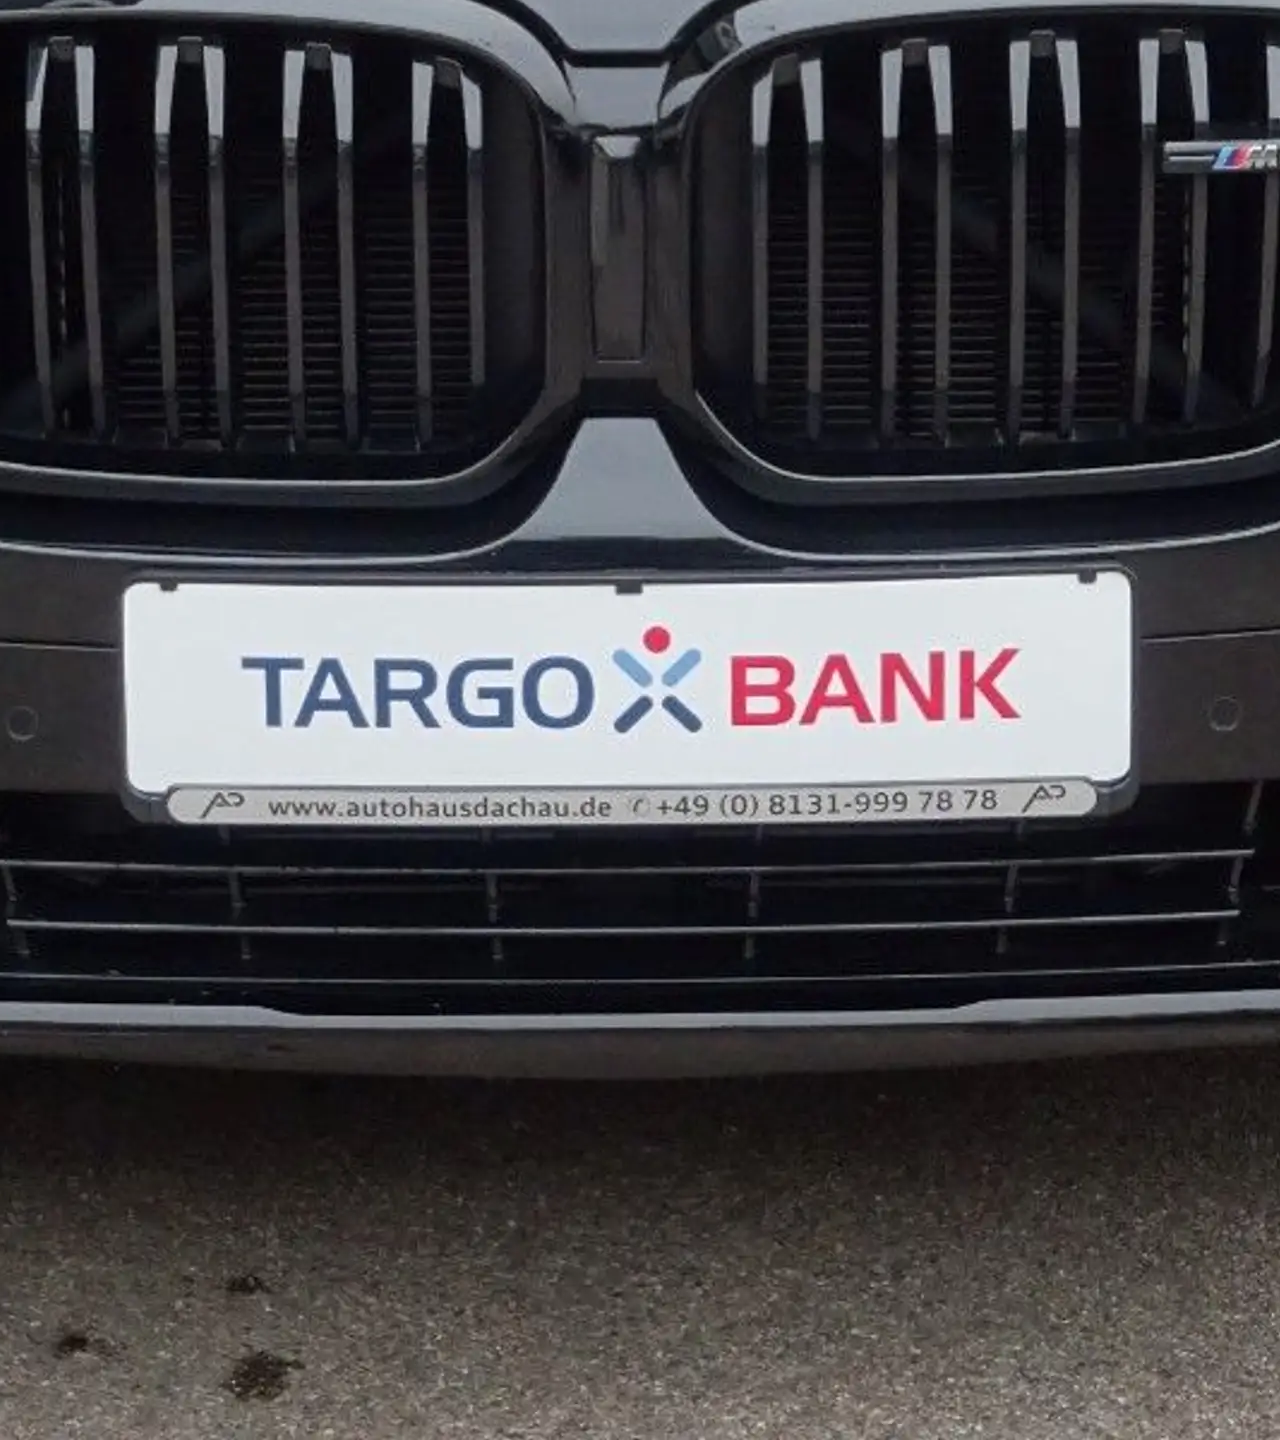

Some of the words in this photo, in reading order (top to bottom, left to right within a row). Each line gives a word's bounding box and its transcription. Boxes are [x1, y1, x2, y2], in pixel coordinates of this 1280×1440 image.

[240, 655, 596, 730] TARGO
[730, 647, 1022, 727] BANK
[267, 796, 612, 819] www.autohausdachau.de
[655, 793, 710, 816] +49
[719, 793, 760, 817] (0)
[768, 790, 909, 814] 8131-999
[919, 789, 954, 812] 78
[963, 788, 999, 811] 78
